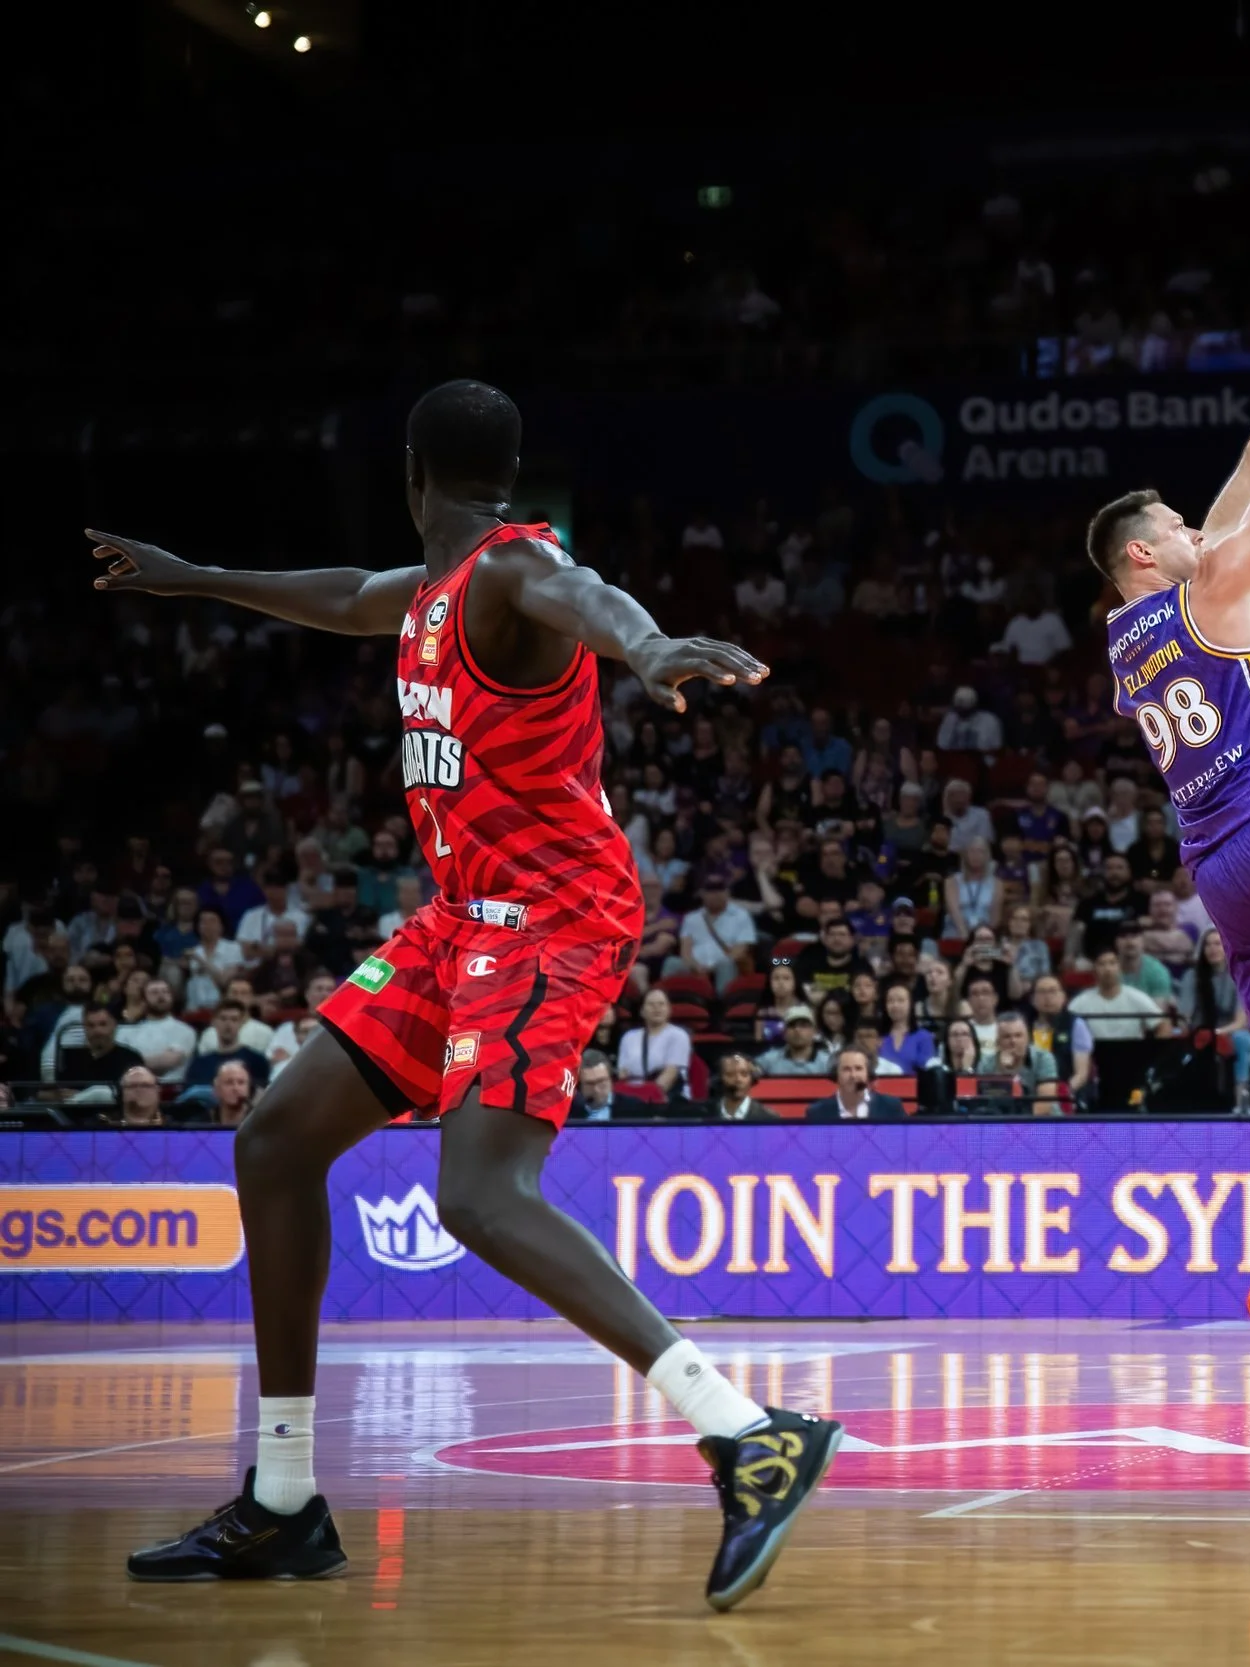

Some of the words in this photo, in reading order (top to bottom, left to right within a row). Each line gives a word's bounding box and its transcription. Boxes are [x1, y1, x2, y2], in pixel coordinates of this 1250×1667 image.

[960, 391, 1121, 434] Qudos
[962, 444, 1109, 481] Arena
[1139, 601, 1175, 634] Bank
[1136, 677, 1222, 774] 98
[420, 797, 452, 858] 2
[611, 1174, 841, 1279] JOIN
[869, 1174, 1081, 1273] THE
